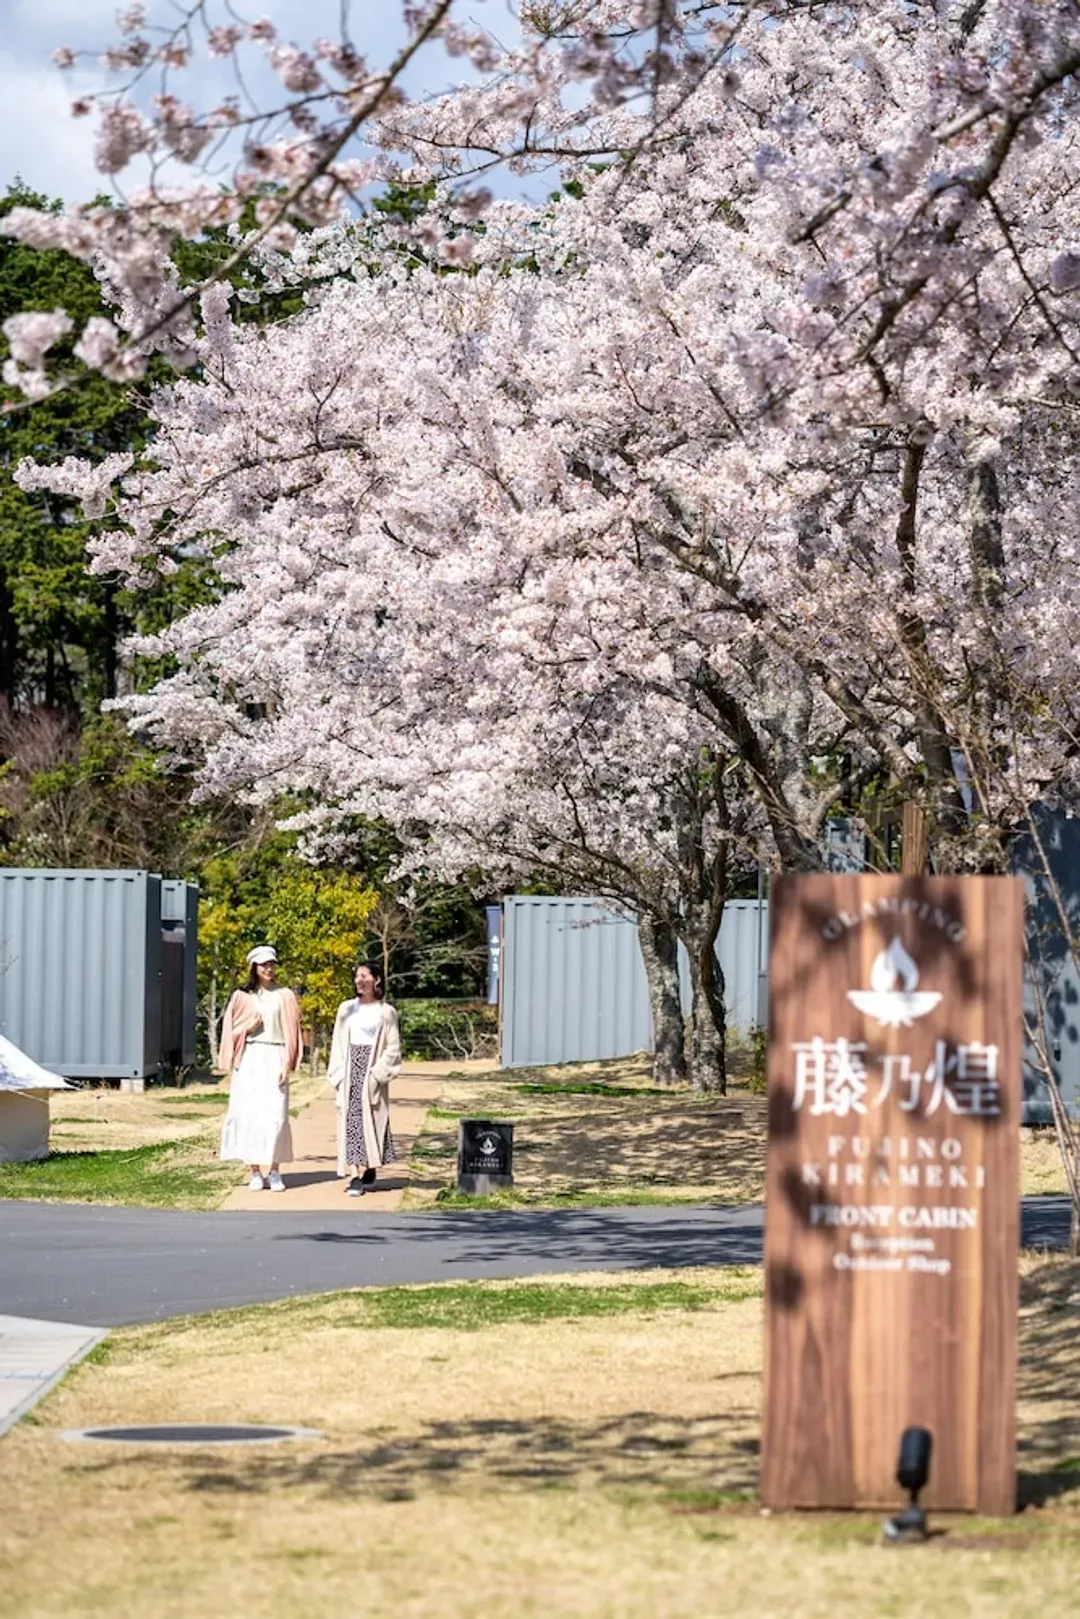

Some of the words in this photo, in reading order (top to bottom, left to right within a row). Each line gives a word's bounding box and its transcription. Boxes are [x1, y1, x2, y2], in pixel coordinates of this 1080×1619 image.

[791, 1036, 1001, 1117] 藤乃煌
[827, 1135, 963, 1160] FUJINO
[801, 1161, 985, 1188] KIRAMEKI
[809, 1204, 894, 1227] FRONT
[898, 1205, 978, 1229] CABIN
